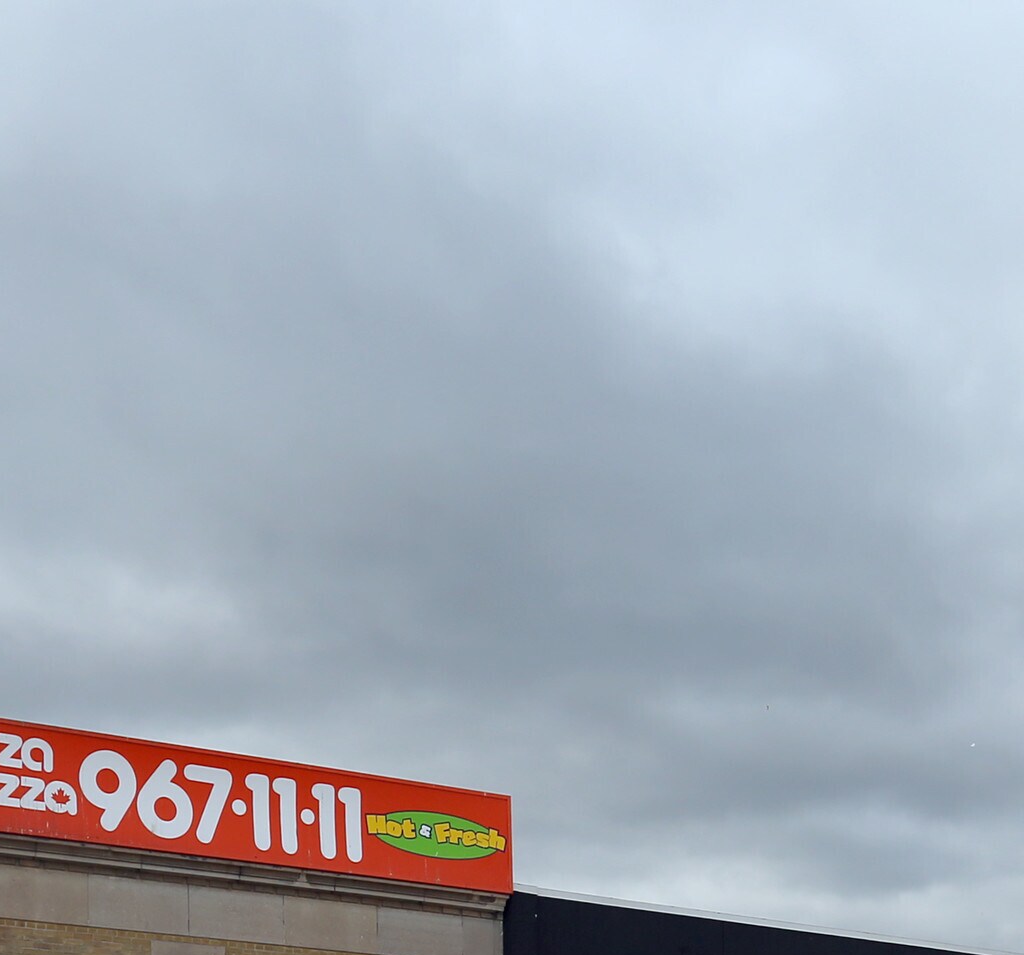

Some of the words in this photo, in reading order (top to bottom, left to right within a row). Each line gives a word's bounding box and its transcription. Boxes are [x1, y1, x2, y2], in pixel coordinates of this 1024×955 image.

[365, 813, 416, 840] Hot
[419, 824, 432, 839] &
[434, 821, 507, 852] Fresh
